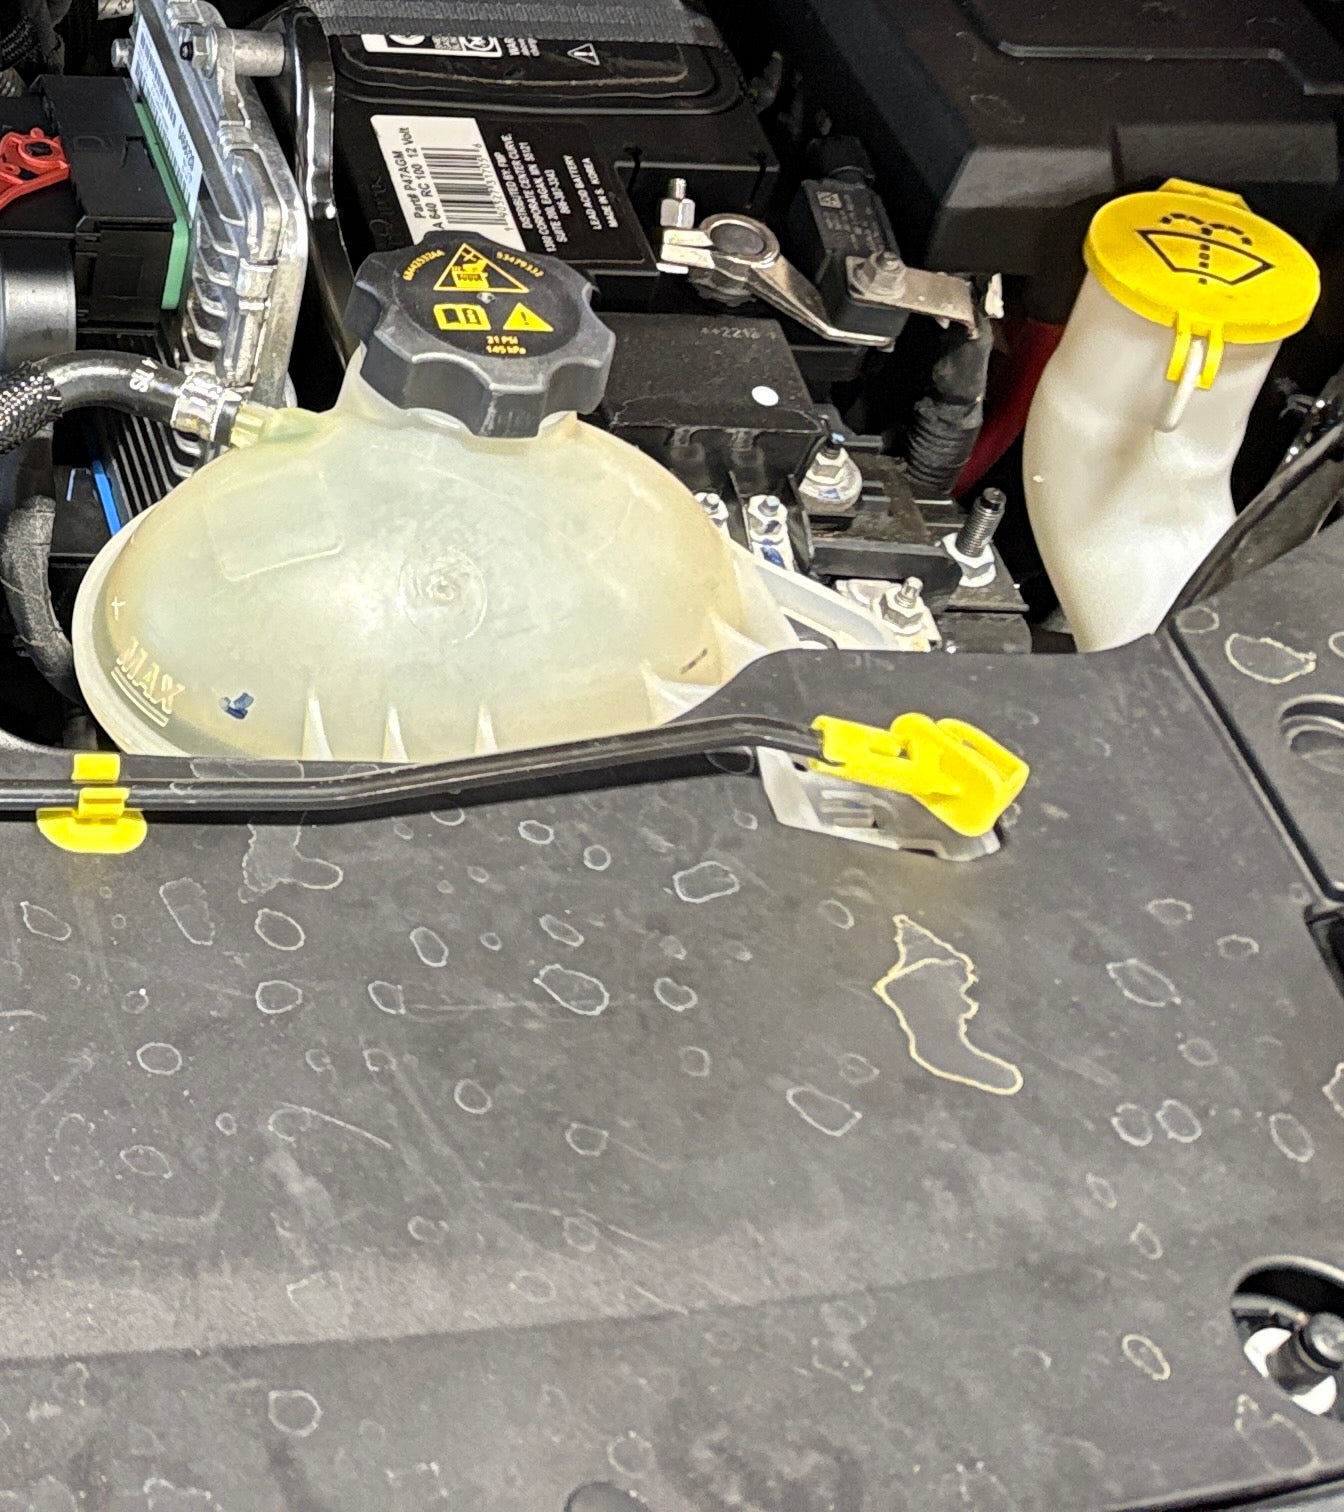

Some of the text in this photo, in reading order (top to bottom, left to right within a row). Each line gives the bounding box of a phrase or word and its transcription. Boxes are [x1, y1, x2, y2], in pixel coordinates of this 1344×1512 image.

[399, 127, 414, 145] Volt
[405, 148, 417, 158] 12
[411, 164, 426, 180] 100
[512, 160, 531, 189] CENTER
[582, 158, 600, 184] KOREA
[392, 151, 426, 218] Part# P47AGM
[418, 183, 432, 197] RC
[563, 155, 602, 230] LEAD ACID BATTERY
[425, 203, 440, 219] 640
[506, 181, 533, 229] DISTRIBUTED
[523, 189, 549, 235] CORPORATE
[597, 196, 608, 204] IN
[601, 204, 618, 228] MADE
[116, 636, 186, 714] MAX
